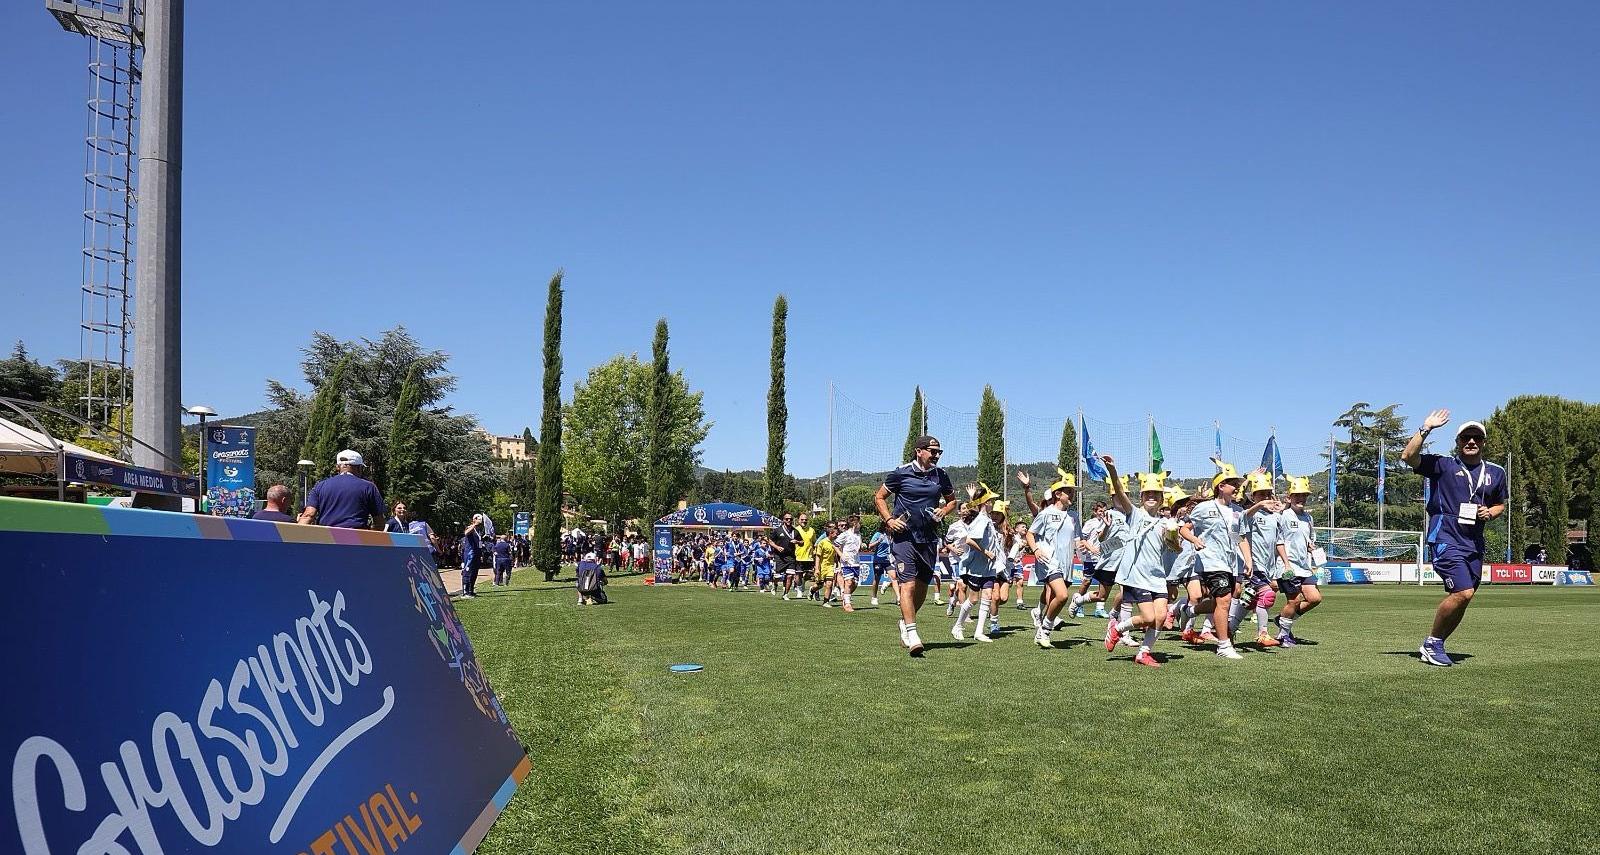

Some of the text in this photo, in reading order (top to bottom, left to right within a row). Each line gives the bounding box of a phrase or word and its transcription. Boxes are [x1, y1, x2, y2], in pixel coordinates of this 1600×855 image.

[124, 472, 164, 489] AREA MEDICA
[1495, 569, 1510, 577] TCL
[1513, 569, 1527, 577] TCL
[12, 589, 373, 855] Grassroots
